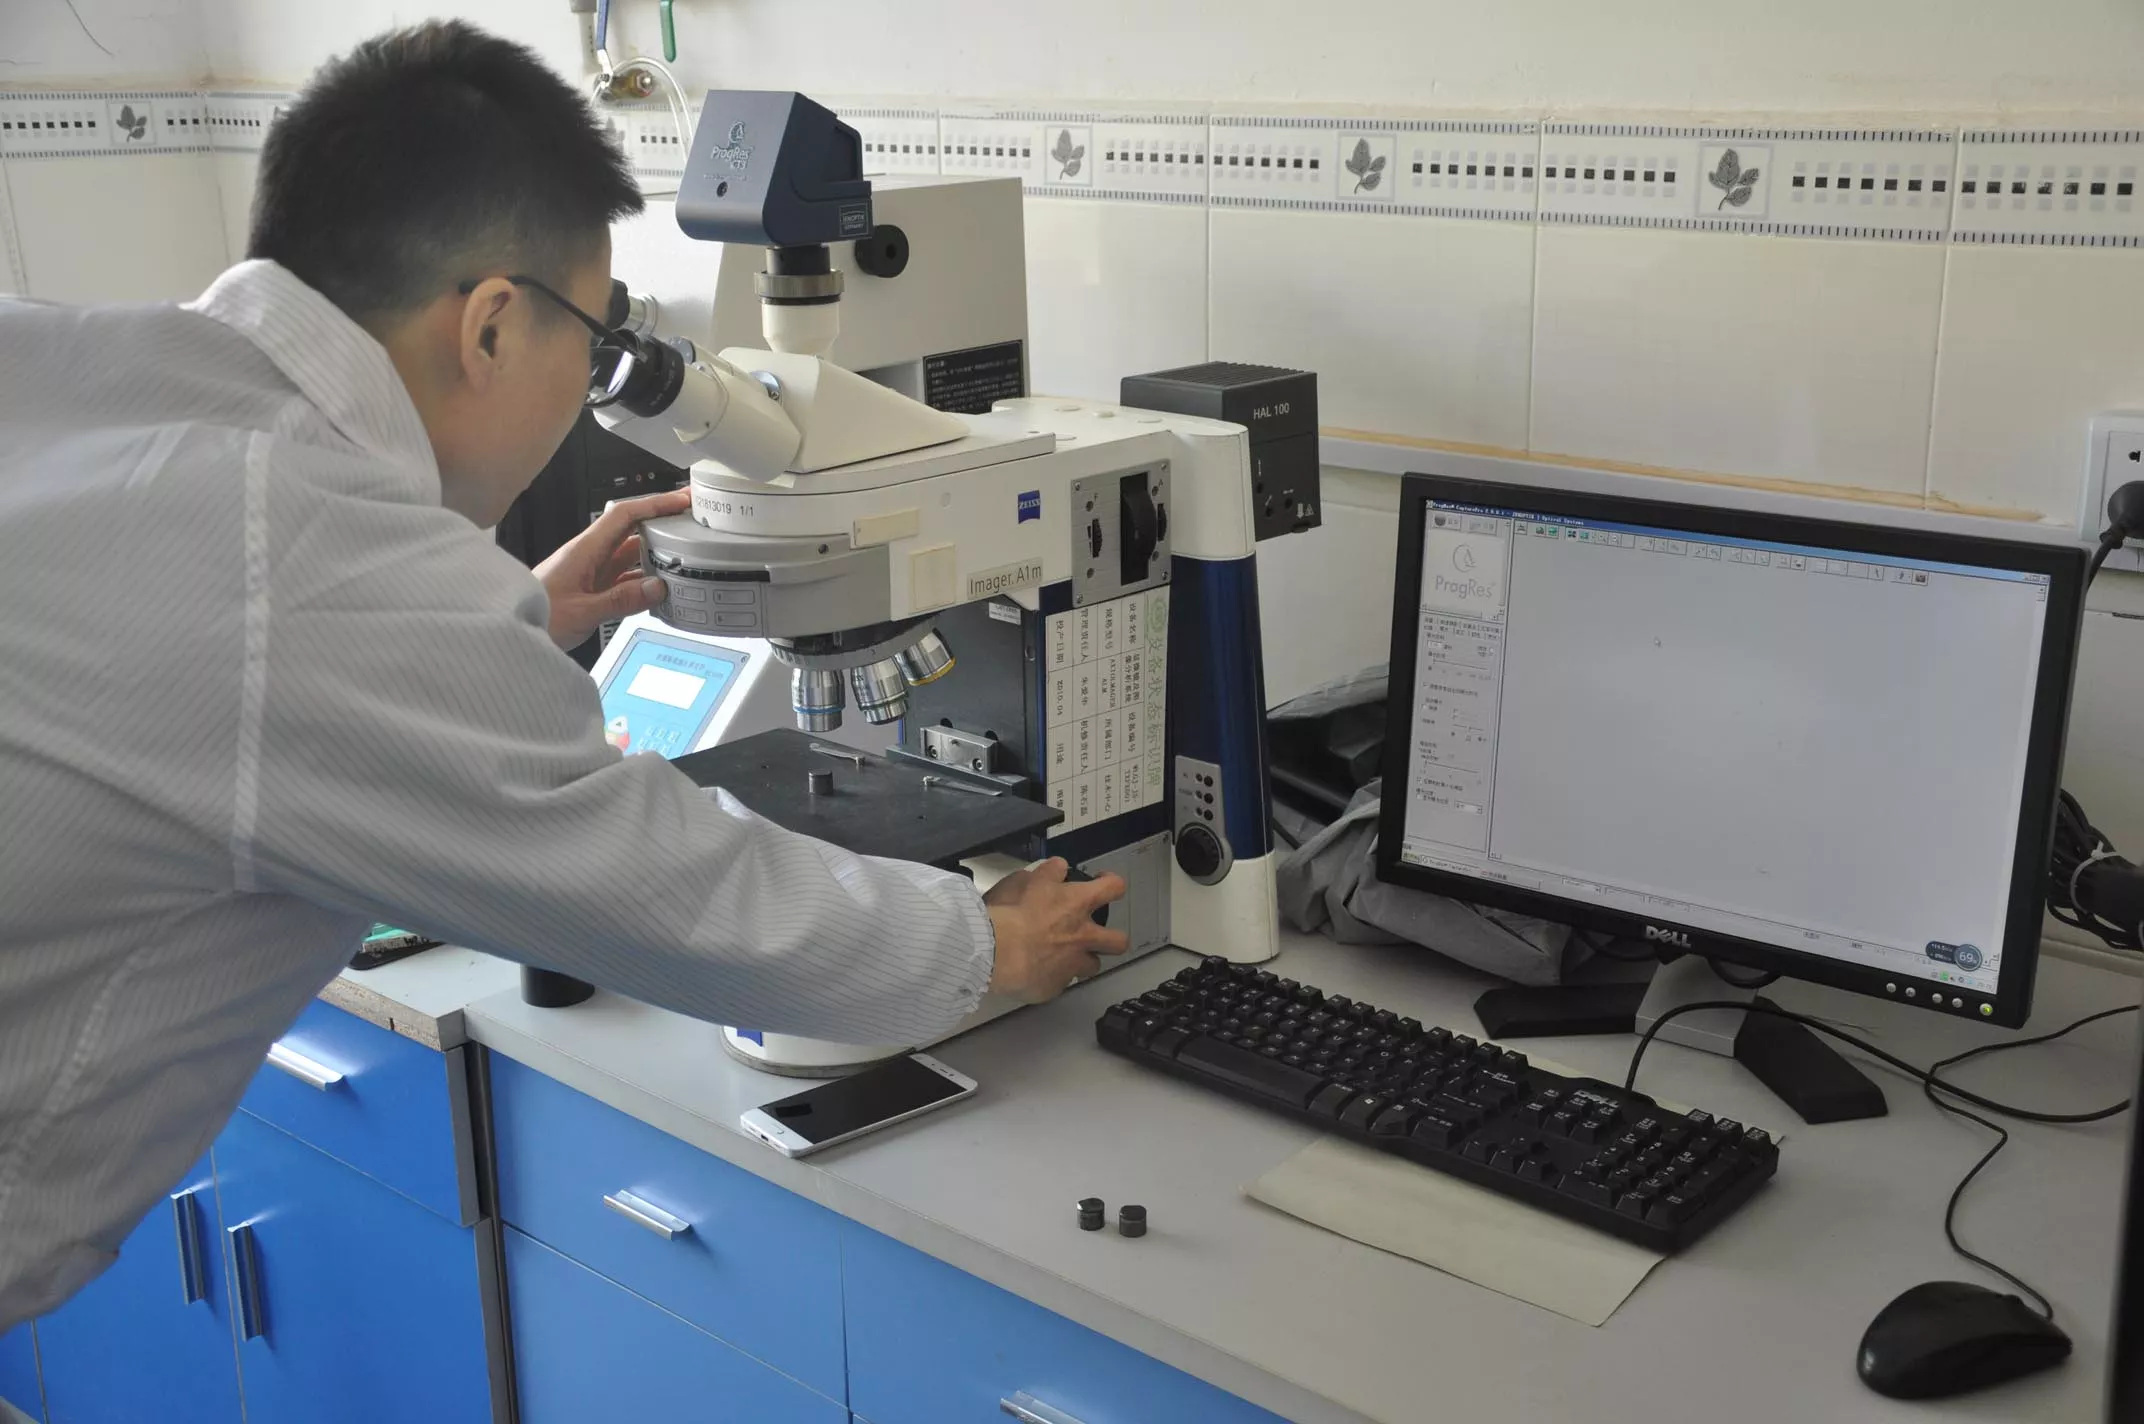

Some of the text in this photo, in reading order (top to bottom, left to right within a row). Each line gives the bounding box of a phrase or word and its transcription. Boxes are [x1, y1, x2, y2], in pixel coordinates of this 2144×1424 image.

[710, 146, 750, 161] ProgRes
[1253, 402, 1290, 420] HAL 100
[740, 505, 754, 516] 1/1
[1019, 498, 1041, 509] ZEISS
[1435, 575, 1492, 600] ProgRes
[1646, 925, 1692, 948] DELL
